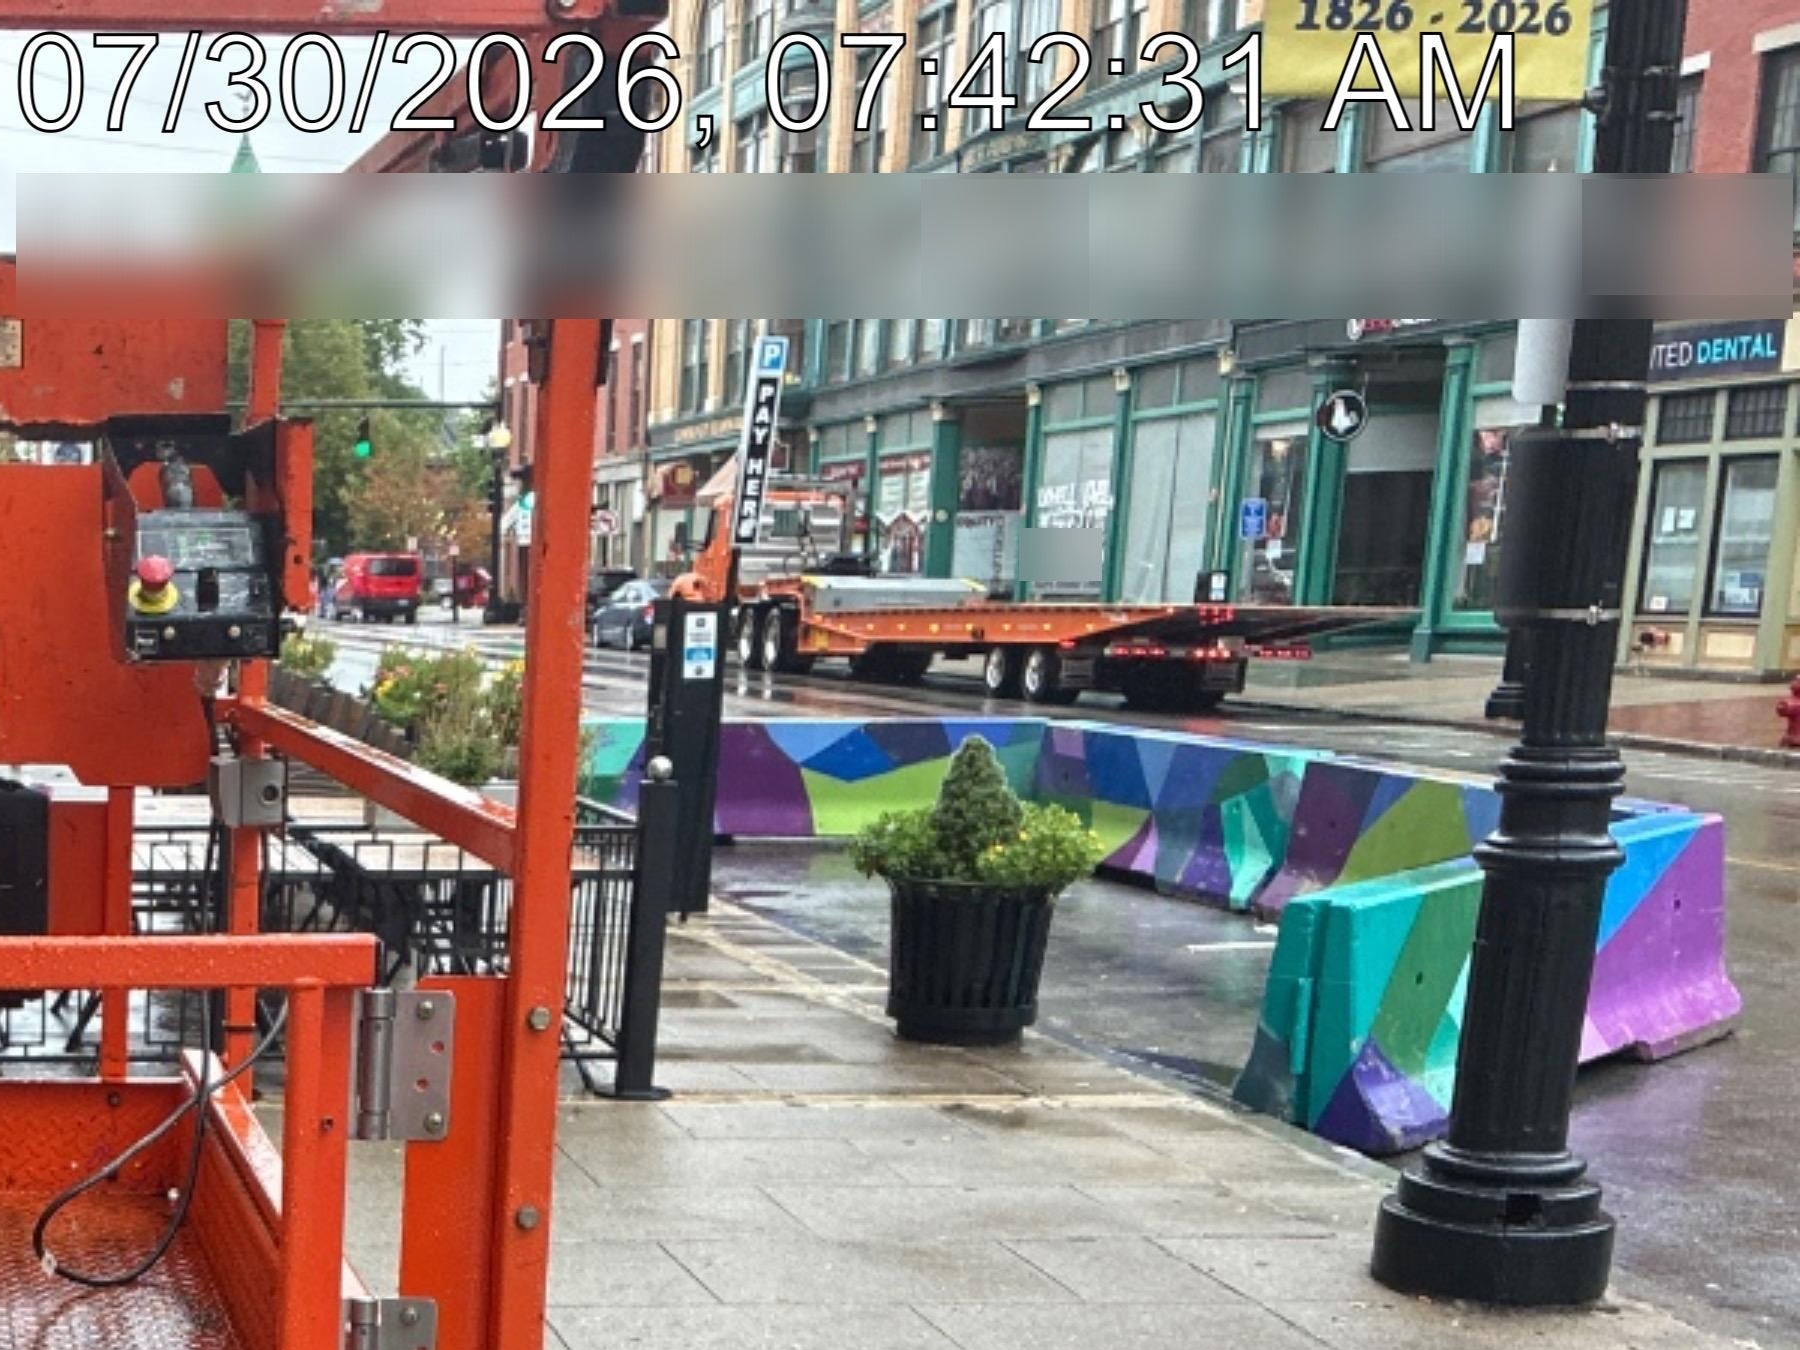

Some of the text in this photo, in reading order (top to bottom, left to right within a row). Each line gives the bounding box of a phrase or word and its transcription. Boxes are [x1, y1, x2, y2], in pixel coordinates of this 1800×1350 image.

[1295, 0, 1414, 31] 1826
[1455, 0, 1571, 36] 2026
[1650, 332, 1777, 370] ITED DENTAL
[754, 384, 774, 446] PAY
